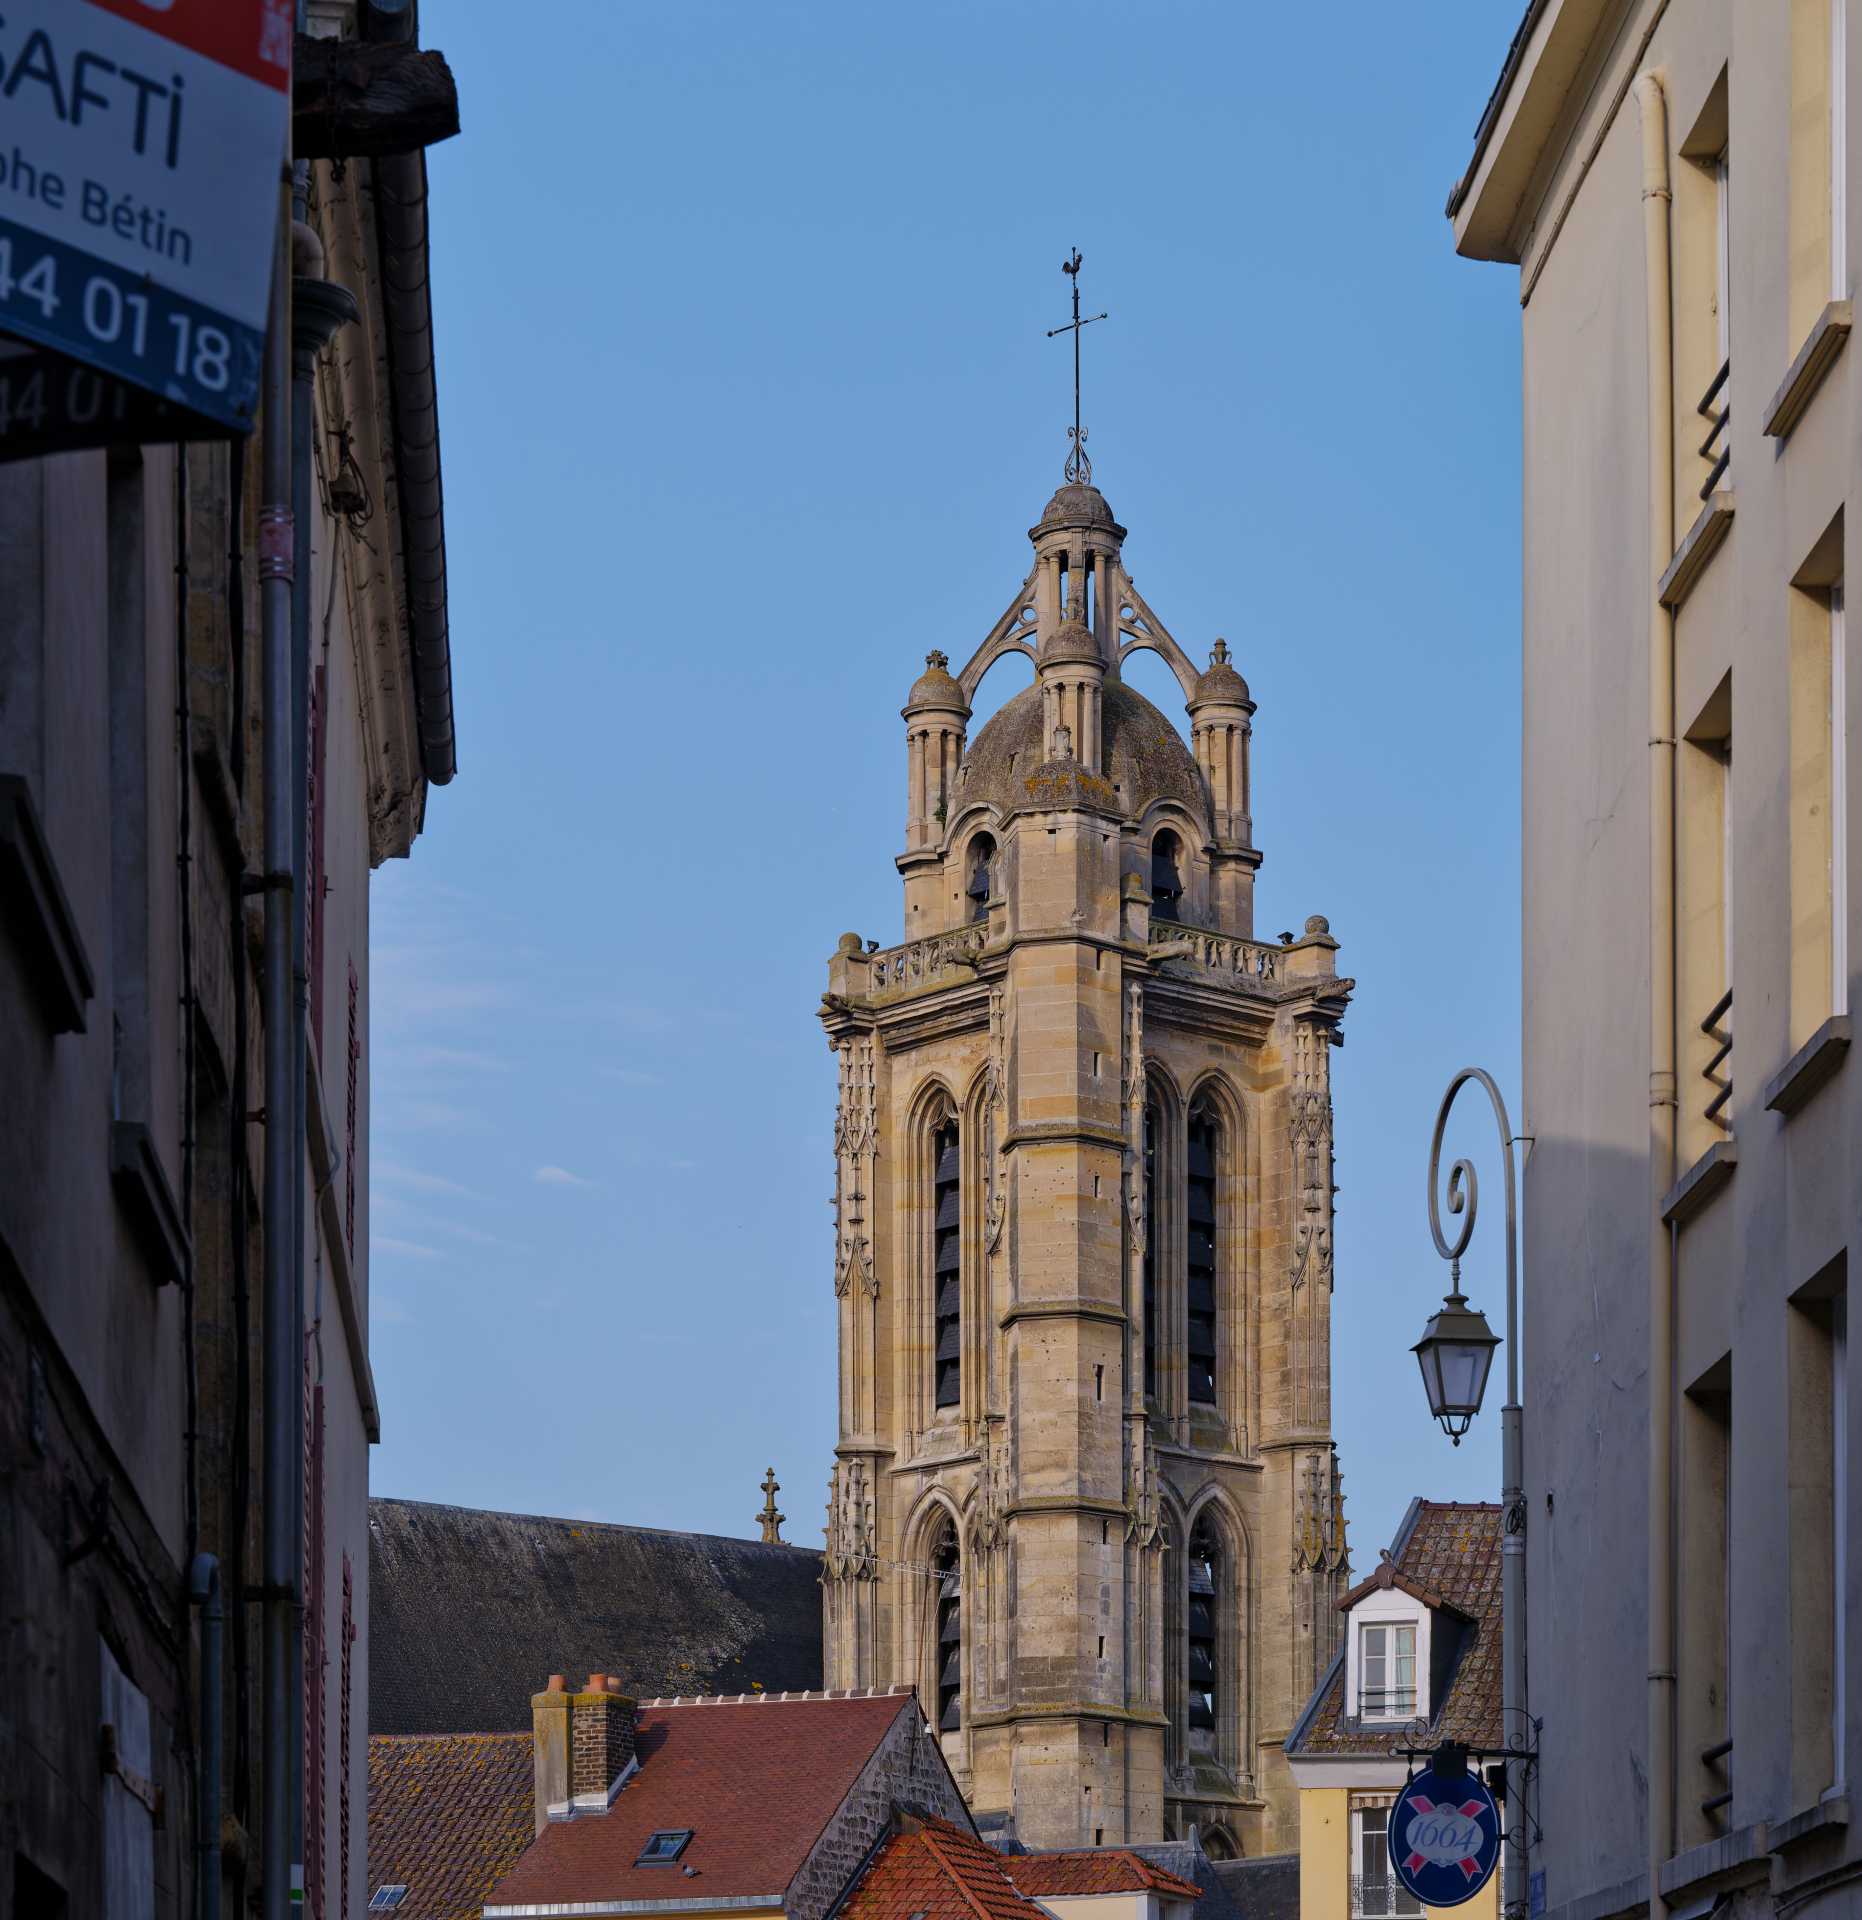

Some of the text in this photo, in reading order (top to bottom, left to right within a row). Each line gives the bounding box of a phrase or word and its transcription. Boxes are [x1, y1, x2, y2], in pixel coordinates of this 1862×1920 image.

[0, 13, 184, 169] AFTi
[0, 147, 191, 267] he Bétin
[83, 276, 148, 357] 01
[168, 313, 230, 392] 18
[1411, 1818, 1481, 1853] 1664
